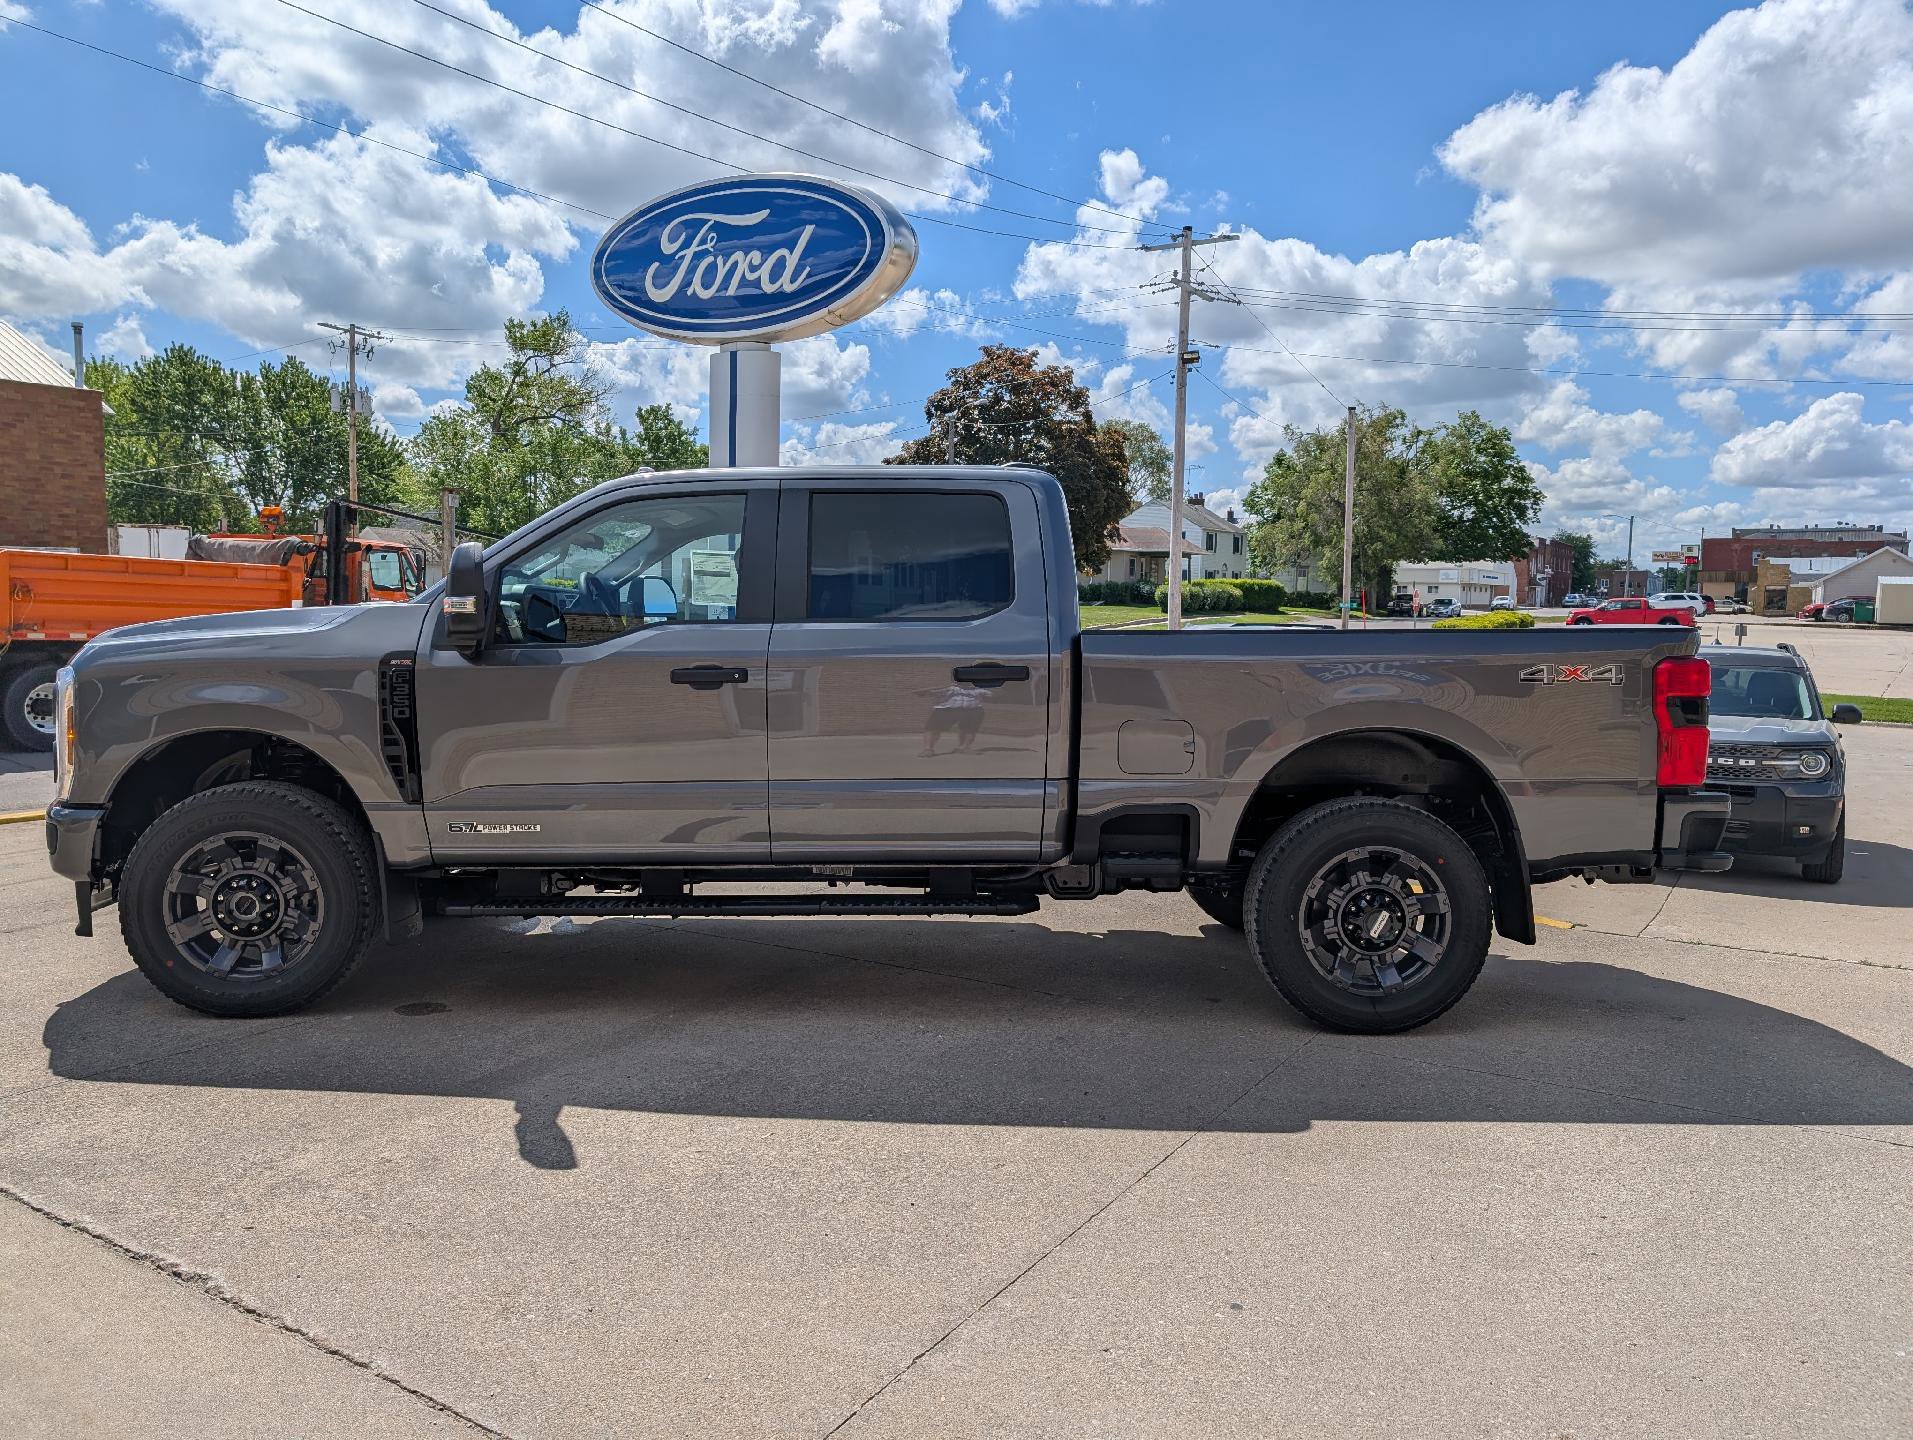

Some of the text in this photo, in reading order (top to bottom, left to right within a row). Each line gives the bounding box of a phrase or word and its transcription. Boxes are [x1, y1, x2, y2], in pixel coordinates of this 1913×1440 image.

[645, 208, 816, 303] Ford
[448, 822, 482, 834] 6.7L
[509, 824, 540, 832] STROKE
